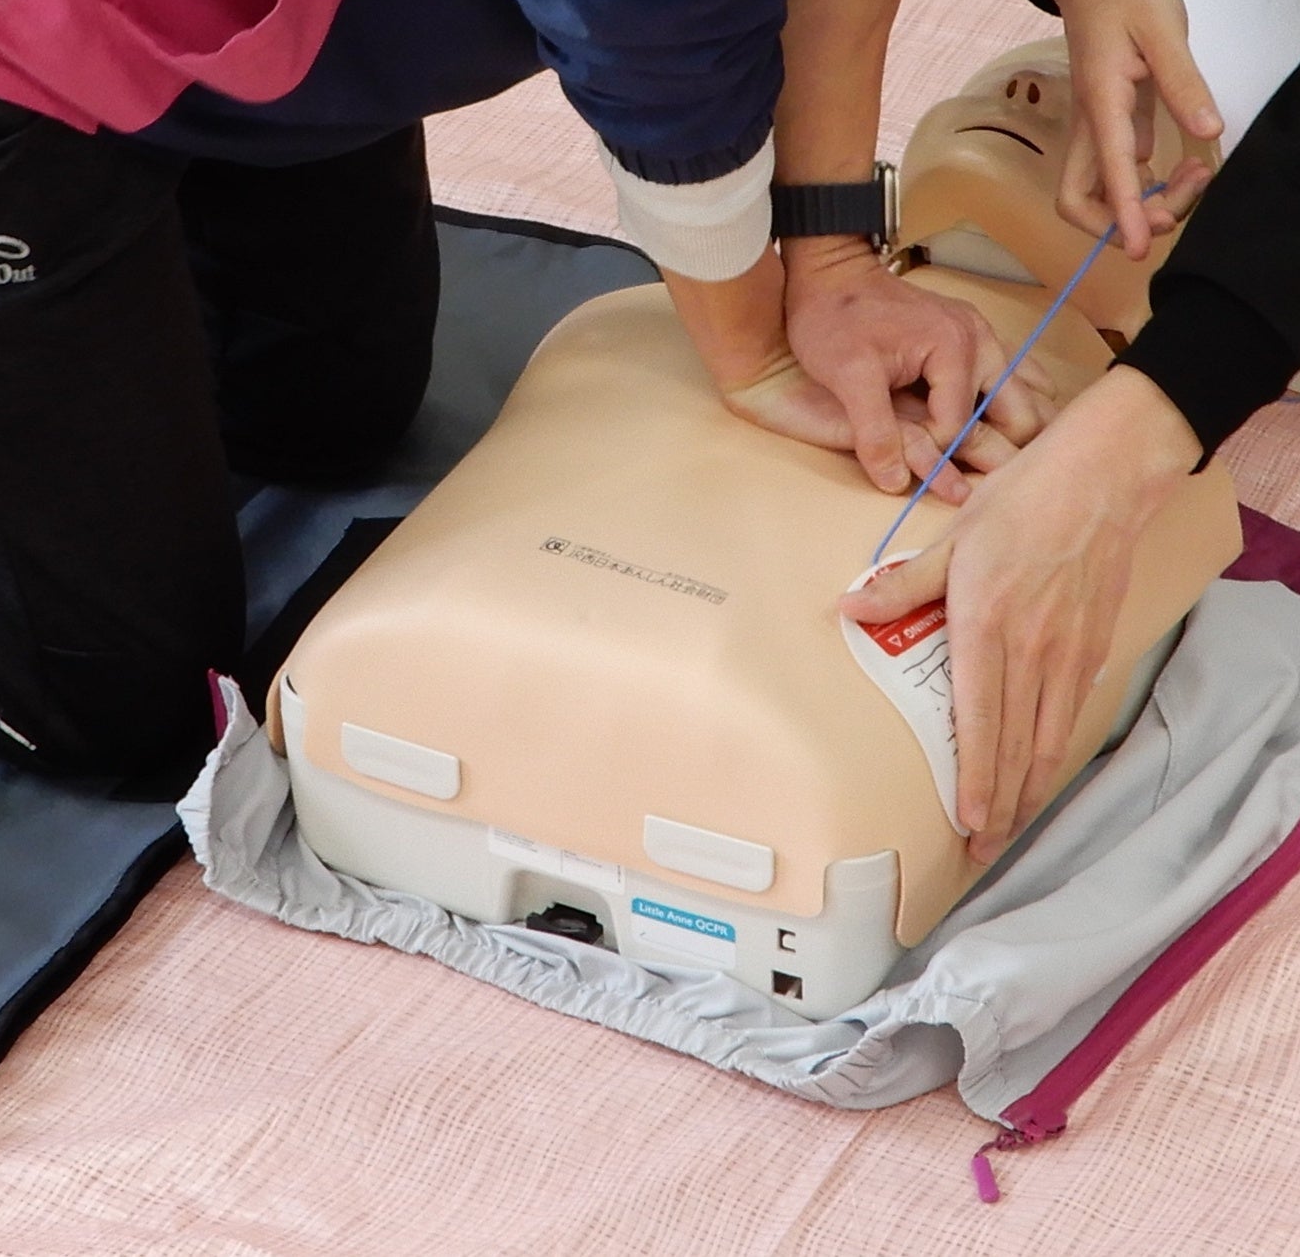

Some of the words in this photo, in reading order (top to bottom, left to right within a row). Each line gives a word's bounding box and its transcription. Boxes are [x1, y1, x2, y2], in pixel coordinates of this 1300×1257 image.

[639, 902, 664, 918] Little
[666, 910, 693, 927] Anne
[695, 919, 729, 937] QCPR
